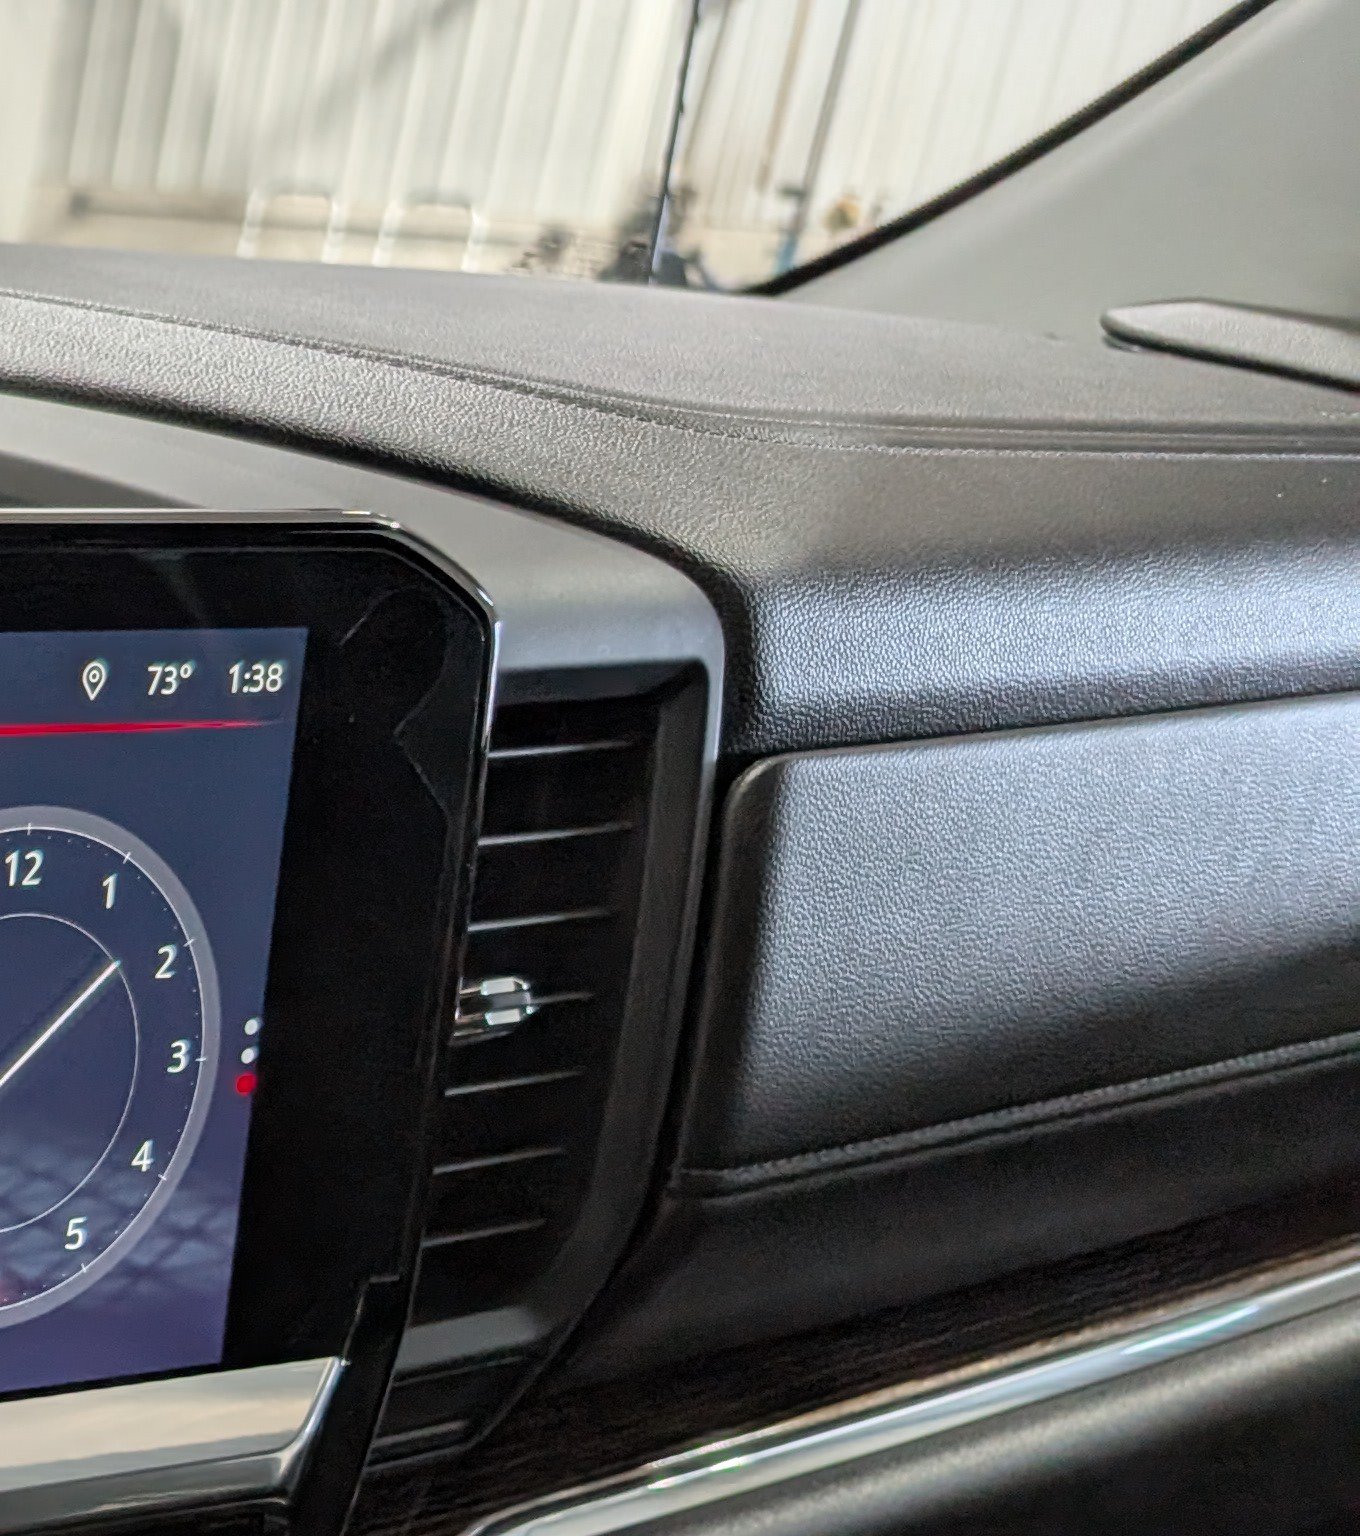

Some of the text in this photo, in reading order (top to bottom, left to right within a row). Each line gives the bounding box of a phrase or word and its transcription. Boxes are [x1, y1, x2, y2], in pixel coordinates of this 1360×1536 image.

[229, 663, 283, 694] 1:38
[5, 850, 43, 887] 12
[102, 874, 117, 910] 1
[154, 945, 176, 979] 2
[166, 1040, 188, 1073] 3
[131, 1140, 153, 1172] 4
[64, 1217, 86, 1250] 5
